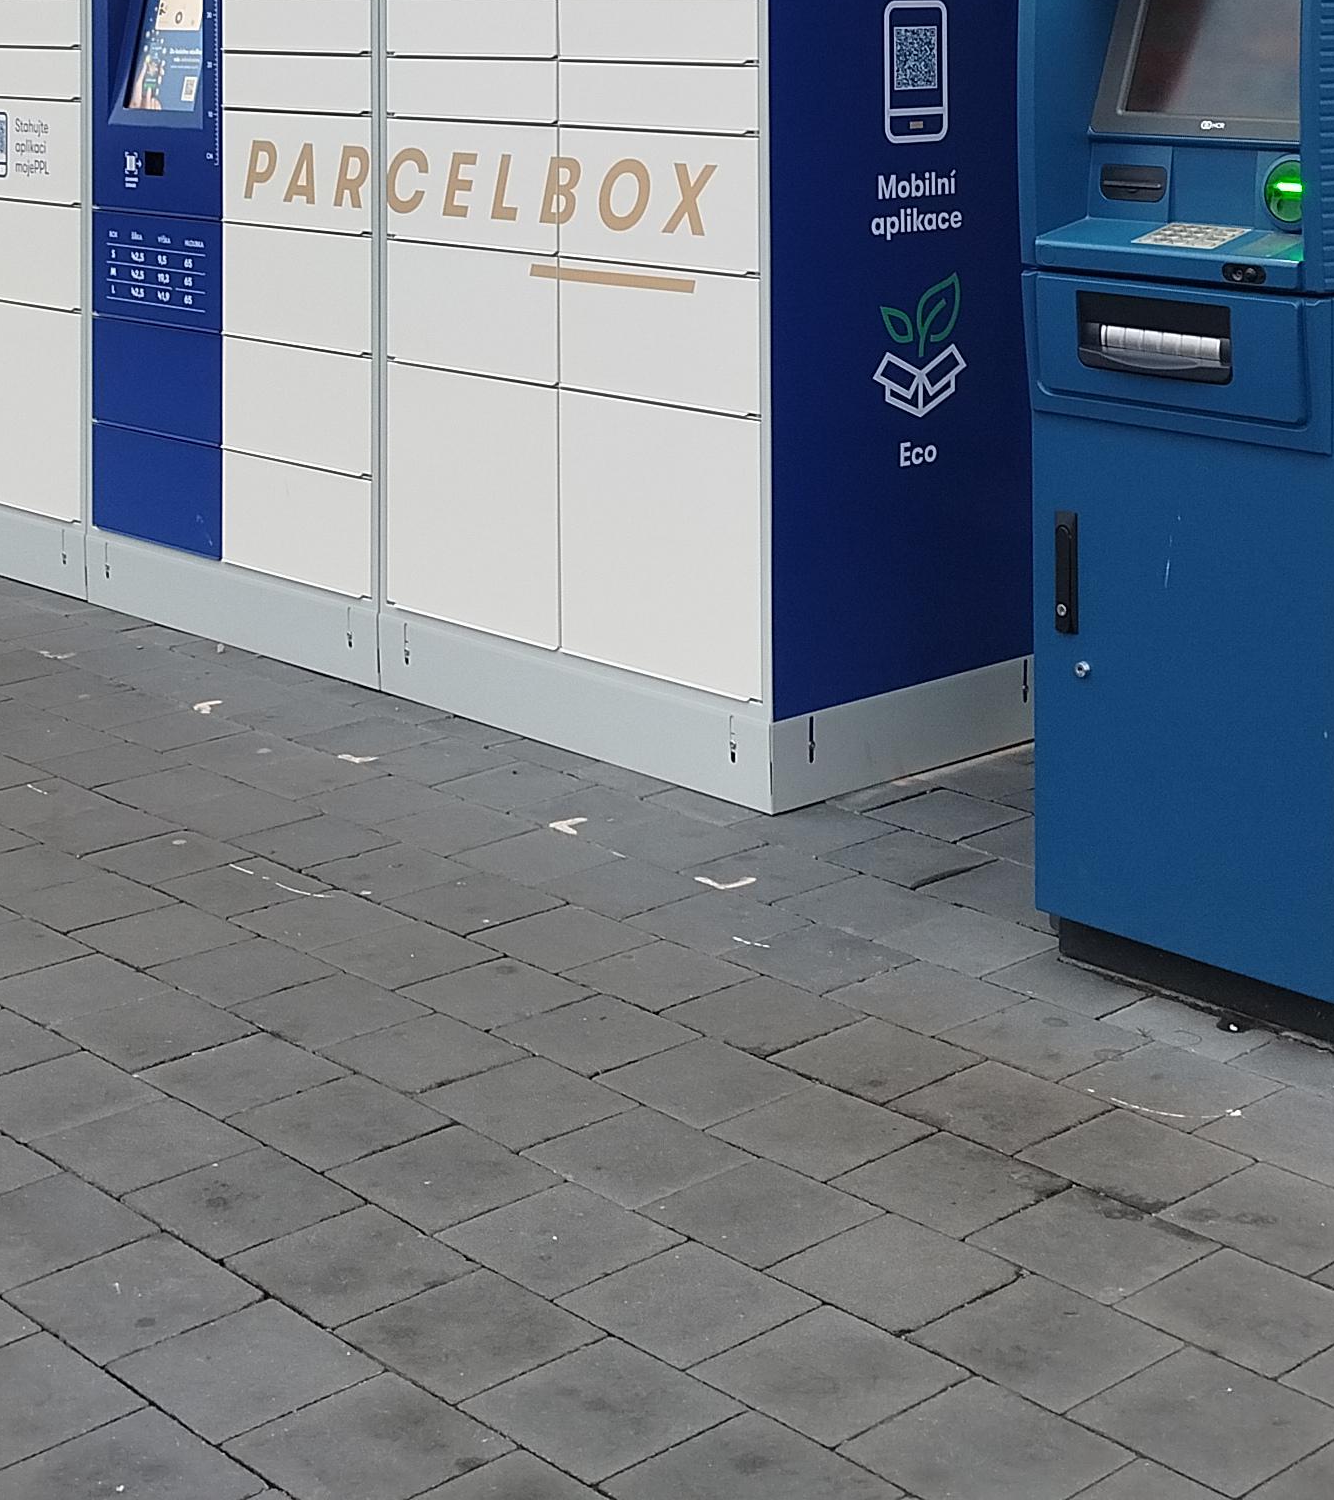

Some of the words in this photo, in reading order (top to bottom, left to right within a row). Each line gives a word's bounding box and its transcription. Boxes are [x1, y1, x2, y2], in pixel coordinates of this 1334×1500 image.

[15, 118, 49, 137] Stahujte
[15, 139, 46, 155] aplikaci
[15, 160, 49, 177] mojePPL
[244, 139, 718, 237] PARCELBOX
[877, 169, 957, 200] Mobilní
[871, 207, 962, 241] aplikace
[900, 441, 937, 467] Eco
